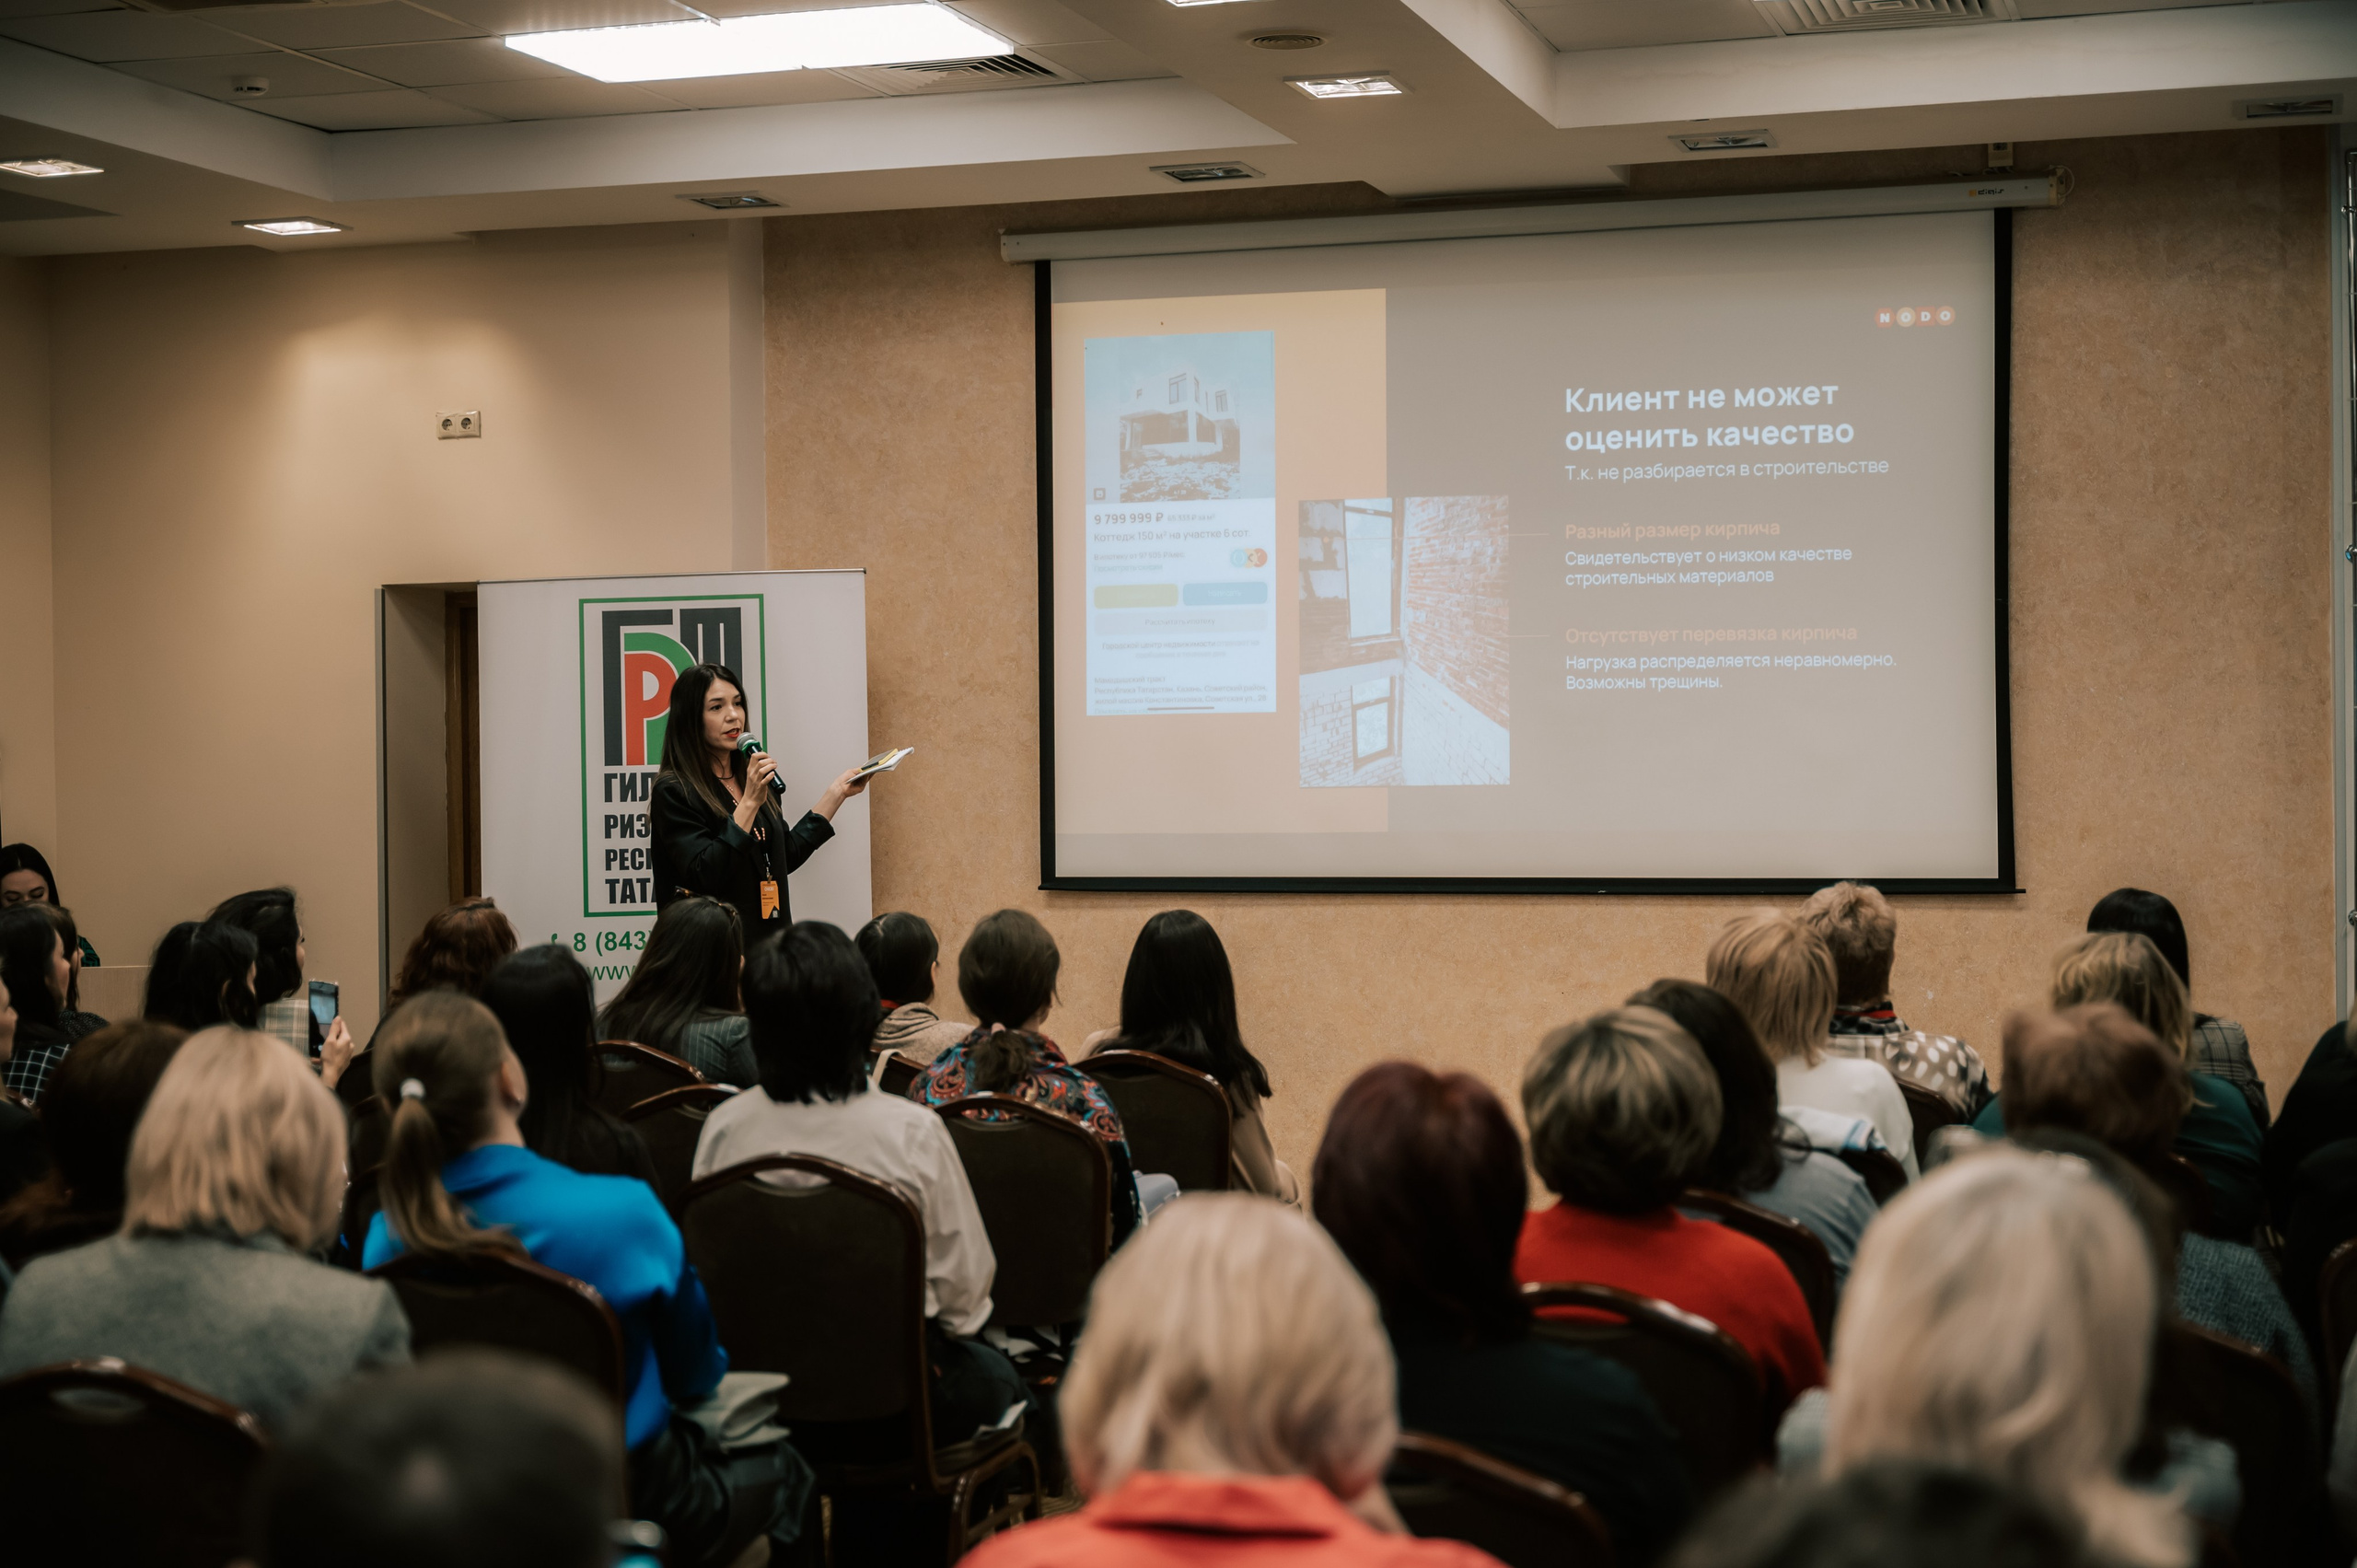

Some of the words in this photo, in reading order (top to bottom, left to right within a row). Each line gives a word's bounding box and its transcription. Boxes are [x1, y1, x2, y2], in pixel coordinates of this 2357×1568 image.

[1879, 310, 1951, 323] NODO
[1565, 388, 1680, 413] Клиент
[1688, 389, 1726, 409] не
[1734, 385, 1839, 408] может
[1565, 428, 1699, 454] оценить
[1707, 423, 1854, 447] качество
[1564, 465, 1594, 481] Т.к.
[1597, 467, 1620, 481] не
[1622, 462, 1736, 484] разбирается
[1739, 463, 1750, 477] в
[1752, 460, 1889, 480] строительстве
[1094, 532, 1135, 542] Коттедж
[1138, 530, 1154, 540] 150
[1169, 531, 1180, 540] на
[1183, 529, 1222, 540] участке
[1224, 528, 1230, 538] 6
[1564, 522, 1632, 540] Разный
[1632, 524, 1702, 541] размер
[1702, 522, 1782, 540] кирпича
[1564, 551, 1702, 567] Свидетельствует
[1705, 551, 1716, 563] о
[1719, 550, 1776, 563] низком
[1779, 548, 1852, 562] качестве
[1565, 572, 1676, 589] строительных
[1678, 570, 1775, 587] материалов
[1564, 626, 1678, 647] Отсутствует
[1681, 628, 1778, 645] перевязка
[1780, 627, 1859, 644] кирпича
[1565, 656, 1637, 673] Нагрузка
[1640, 655, 1771, 672] распределяется
[1773, 654, 1897, 671] неравномерно.
[1566, 675, 1646, 691] Возможны
[1649, 677, 1723, 692] трещины.
[604, 772, 658, 803] ГИЛ
[604, 813, 651, 839] РИЭ
[605, 877, 656, 904] ТАТ
[574, 932, 586, 952] 8
